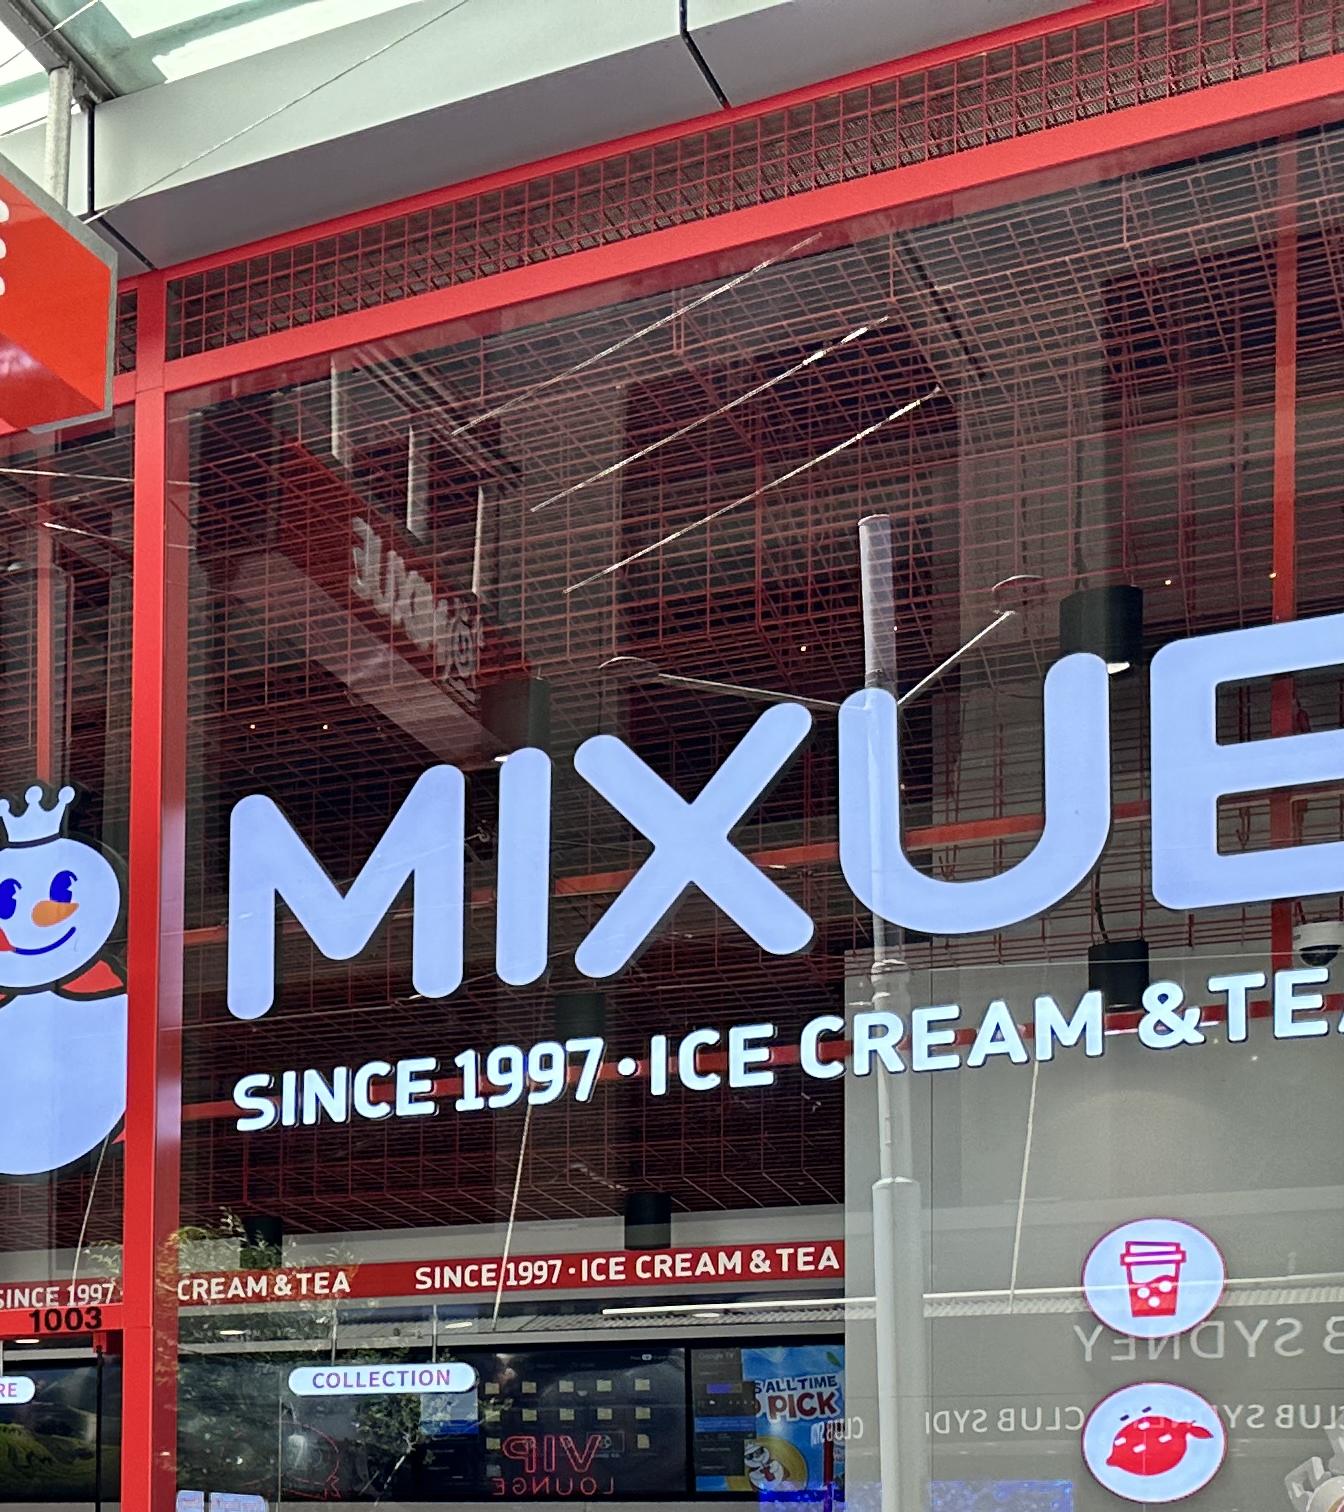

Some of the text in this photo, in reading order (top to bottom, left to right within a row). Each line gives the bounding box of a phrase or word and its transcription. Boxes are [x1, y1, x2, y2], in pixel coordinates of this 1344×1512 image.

[226, 616, 1344, 1020] MIXUE
[234, 1055, 438, 1133] SINCE
[799, 988, 1104, 1079] CREAM
[1208, 967, 1344, 1043] TE
[415, 1263, 497, 1291] SINCE
[635, 1250, 745, 1280] CREAM
[750, 1249, 771, 1275] &
[775, 1246, 840, 1274] TEA
[177, 1276, 268, 1302] CREAM
[293, 1270, 351, 1295] TEA
[28, 1306, 103, 1333] 1003
[311, 1370, 452, 1389] COLLECTION
[797, 1375, 837, 1390] TIME
[767, 1391, 837, 1420] PICK
